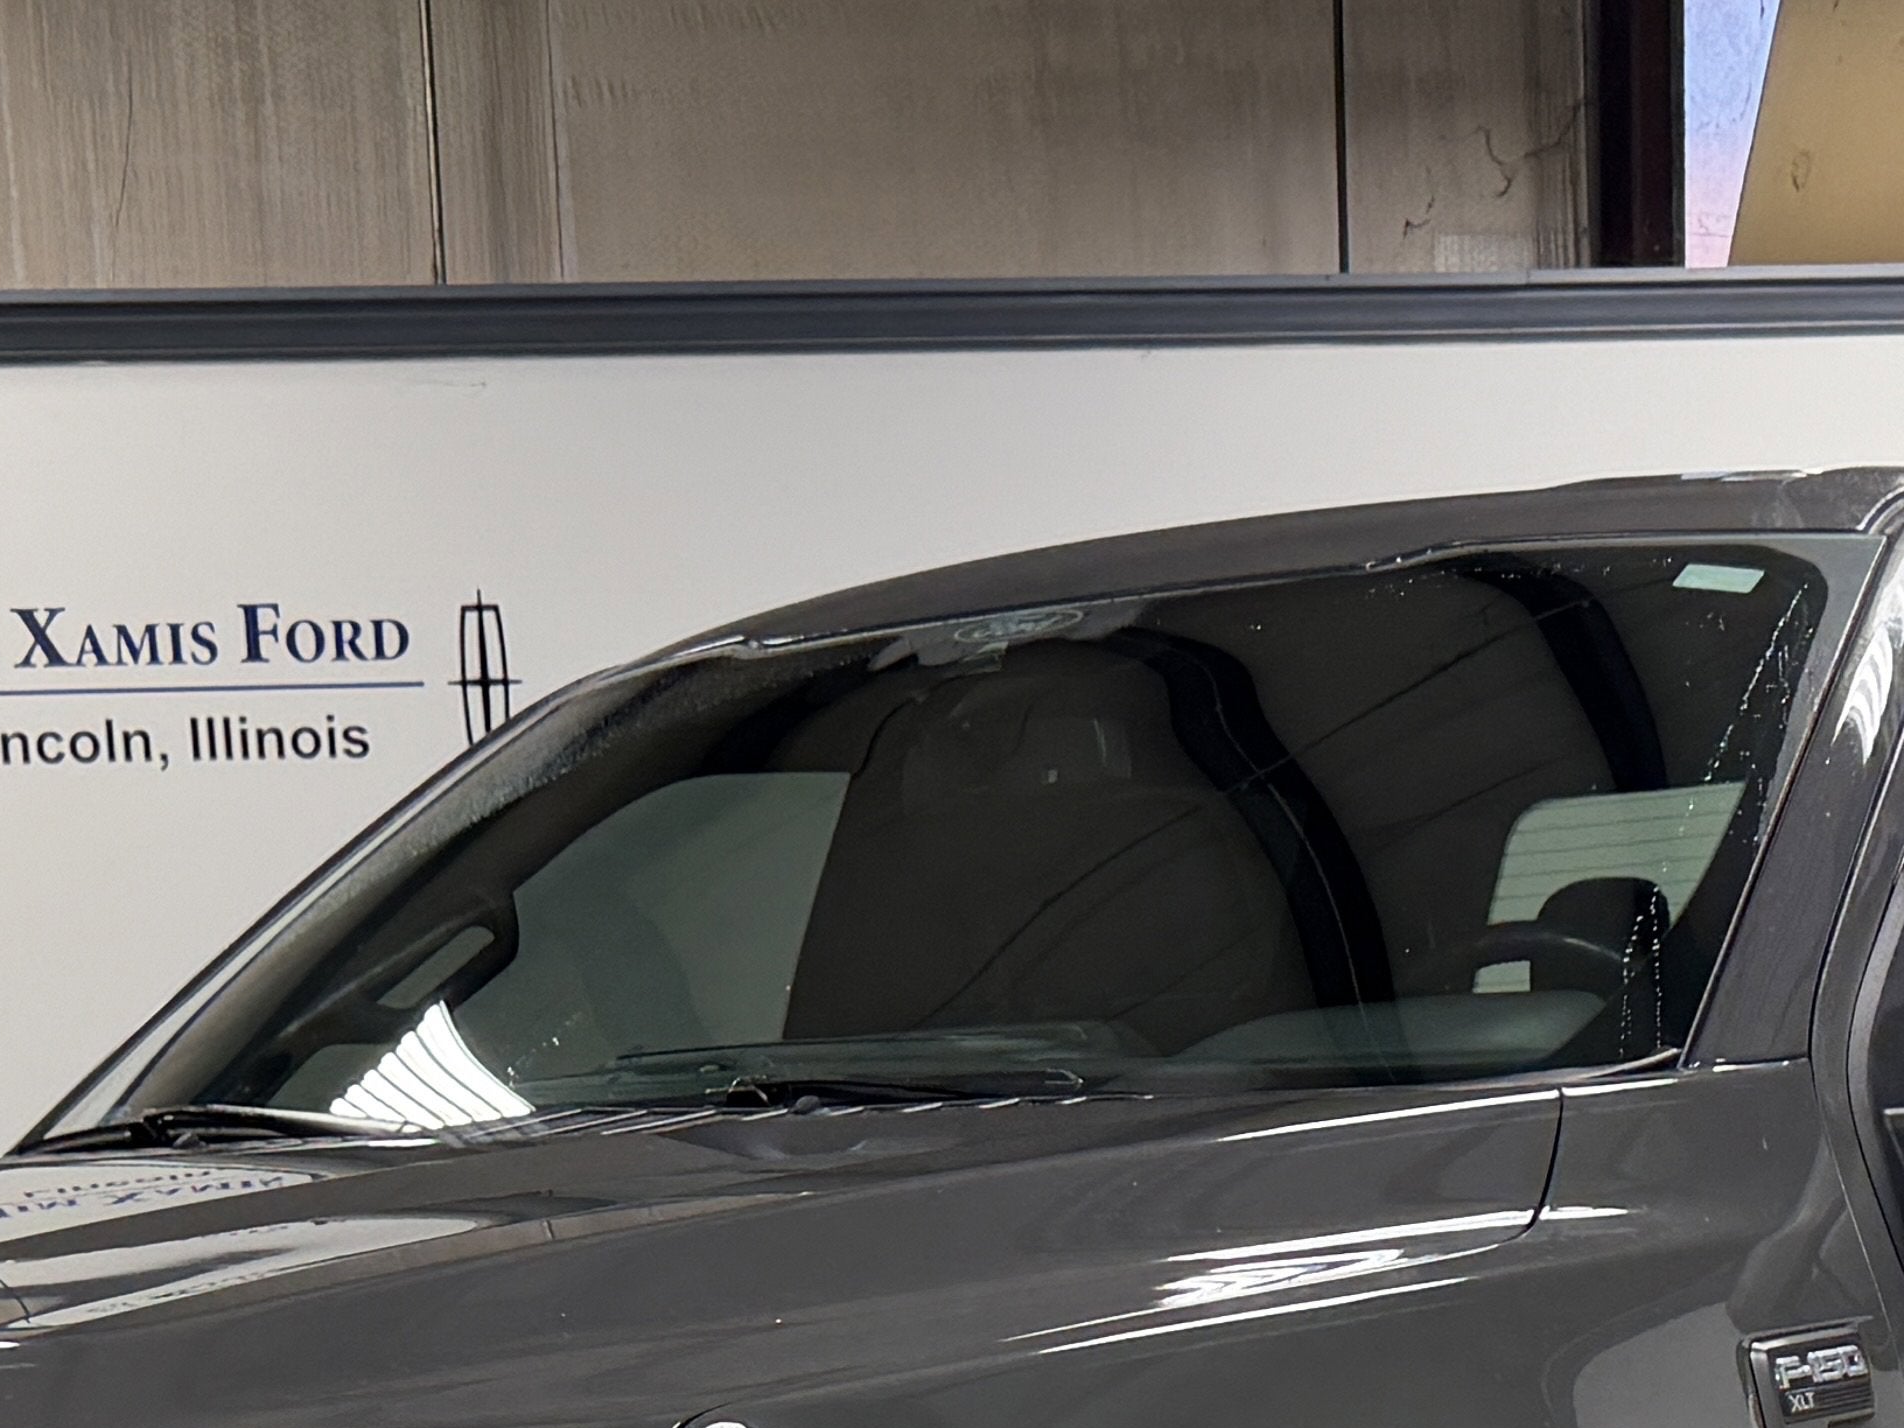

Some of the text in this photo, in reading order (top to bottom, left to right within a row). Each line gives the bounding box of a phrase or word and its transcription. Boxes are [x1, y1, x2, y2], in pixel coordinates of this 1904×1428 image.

[9, 606, 219, 669] XAMIS
[237, 602, 411, 663] FORD
[188, 713, 371, 763] Illinois
[1788, 1392, 1815, 1413] XLT
